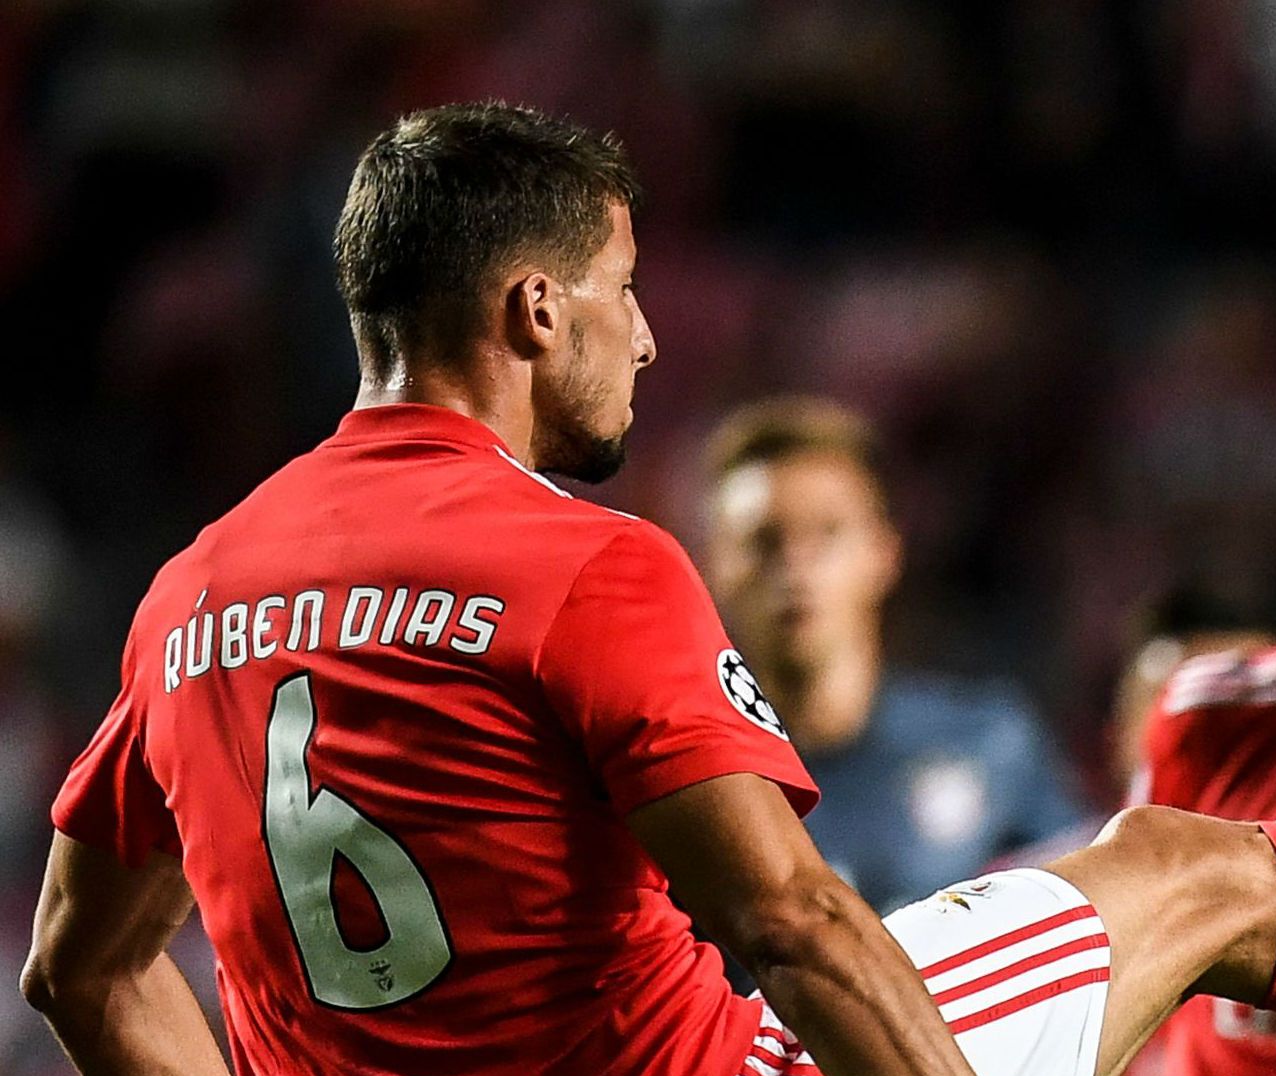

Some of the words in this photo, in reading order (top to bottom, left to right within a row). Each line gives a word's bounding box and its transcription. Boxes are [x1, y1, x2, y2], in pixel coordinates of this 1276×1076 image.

[164, 587, 325, 694] RÚBEN
[337, 586, 505, 656] DIAS
[263, 672, 453, 1011] 6
